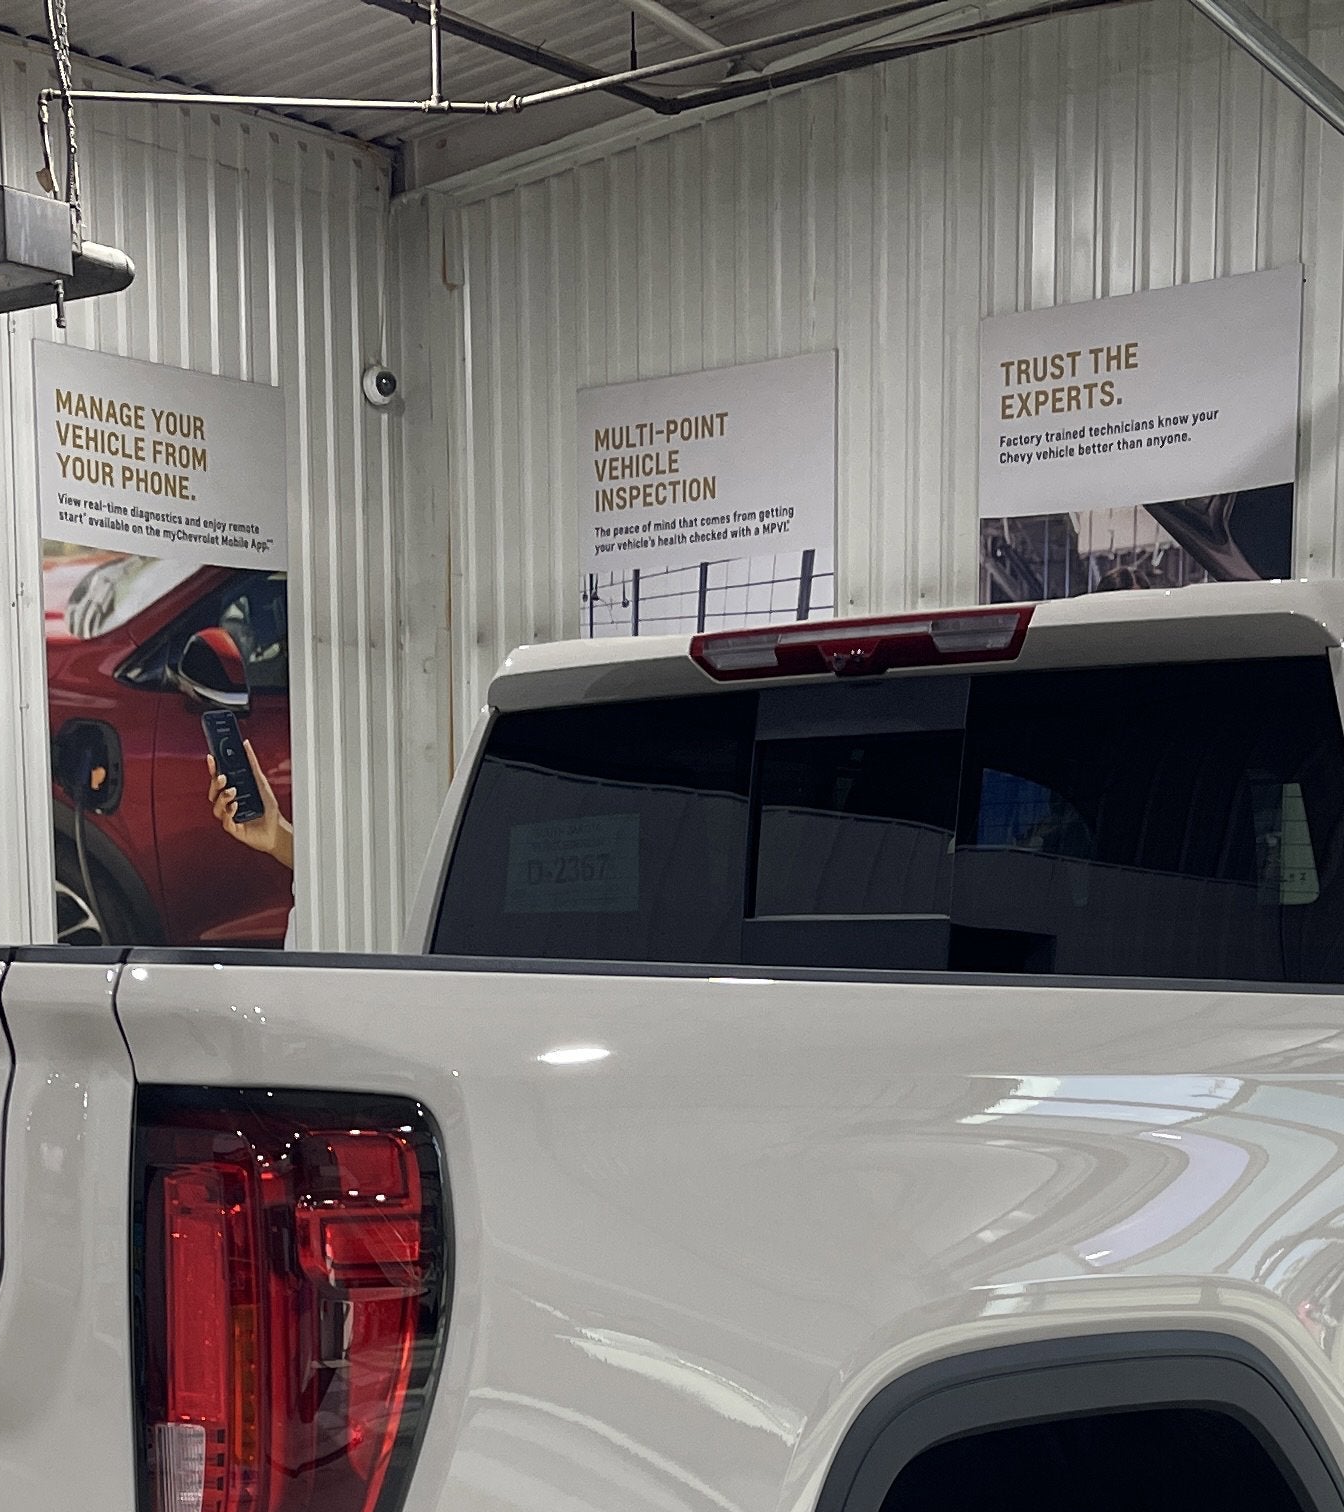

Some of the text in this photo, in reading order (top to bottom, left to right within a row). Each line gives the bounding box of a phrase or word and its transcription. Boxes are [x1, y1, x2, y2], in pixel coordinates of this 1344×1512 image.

[1000, 342, 1139, 387] TRUST THE
[56, 388, 206, 440] MANAGE YOUR
[1000, 380, 1123, 421] EXPERTS.
[56, 420, 207, 473] VEHICLE FROM
[594, 411, 729, 452] MULTI-POINT
[999, 409, 1220, 448] Factory trained technicians know your
[999, 432, 1192, 465] Chevy vehicle better than anyone.
[56, 452, 196, 501] YOUR PHONE.
[594, 449, 680, 482] VEHICLE
[57, 492, 260, 534] View real-time diagnostics and enjoy remote
[594, 476, 716, 512] INSPECTION
[88, 516, 129, 532] available
[132, 524, 144, 534] on
[145, 525, 160, 538] the
[163, 529, 219, 546] myChevrolet
[221, 534, 249, 549] Mobile
[594, 506, 794, 539] The peace of mind that comes from getting
[594, 542, 615, 556] your
[617, 536, 656, 552] vehicle's
[657, 532, 687, 547] health
[689, 528, 728, 543] checked
[730, 525, 752, 539] with
[754, 527, 760, 536] a
